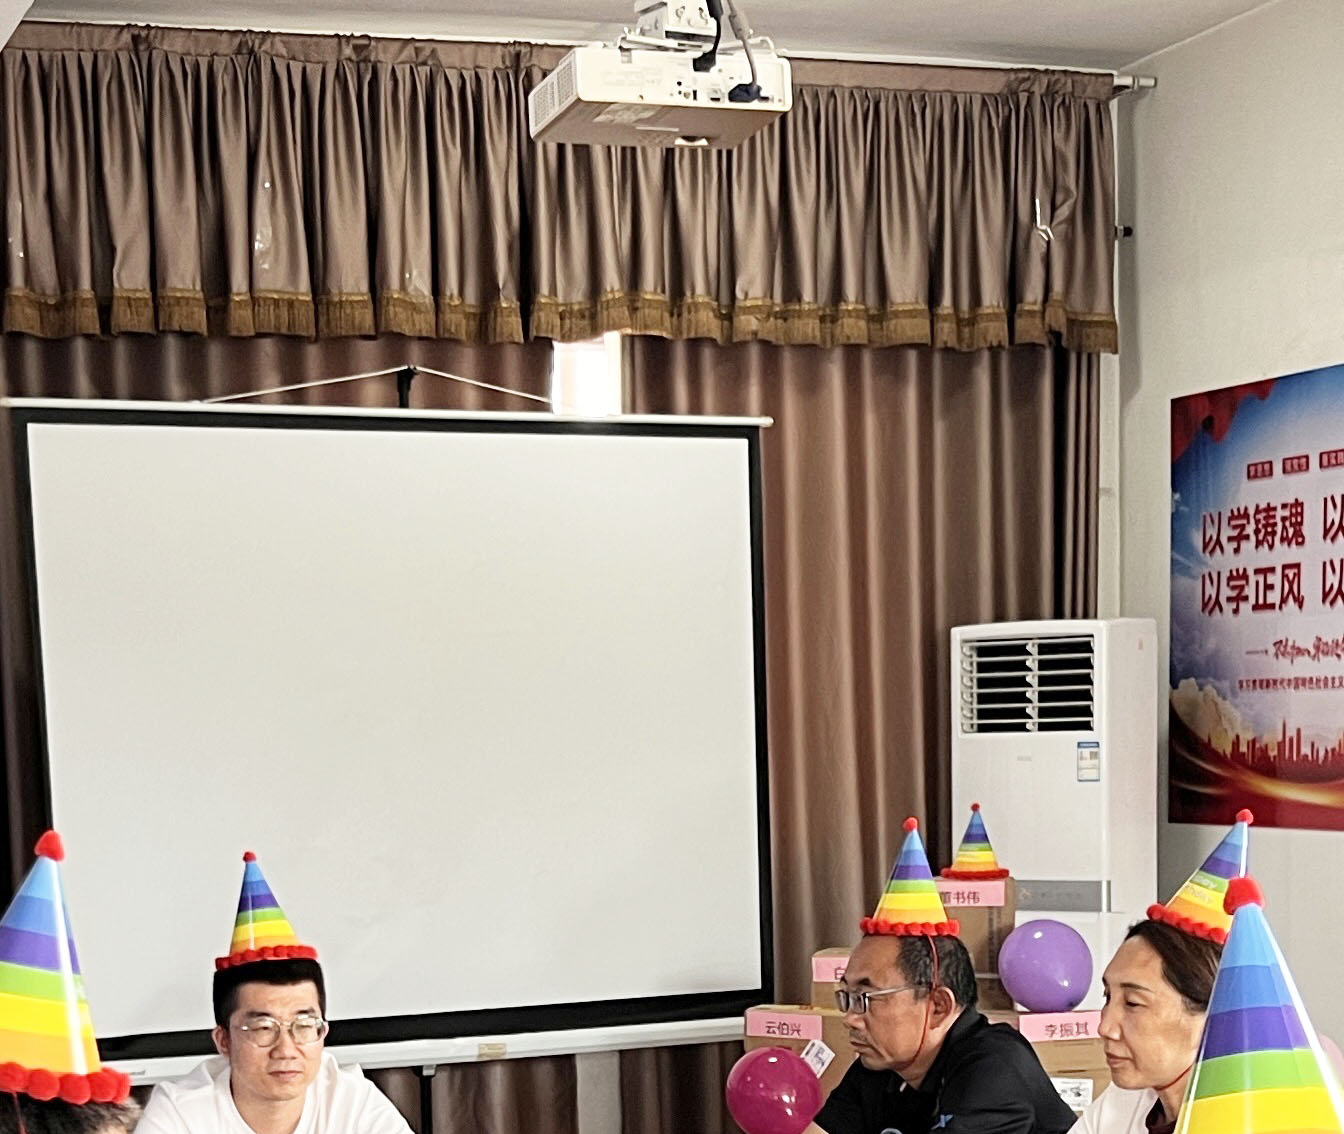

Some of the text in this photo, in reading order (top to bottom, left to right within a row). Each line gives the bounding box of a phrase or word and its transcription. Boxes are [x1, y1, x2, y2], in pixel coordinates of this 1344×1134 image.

[1201, 498, 1307, 557] 以学铸魂
[1200, 562, 1305, 617] 以学正风
[765, 1021, 801, 1037] 云伯兴
